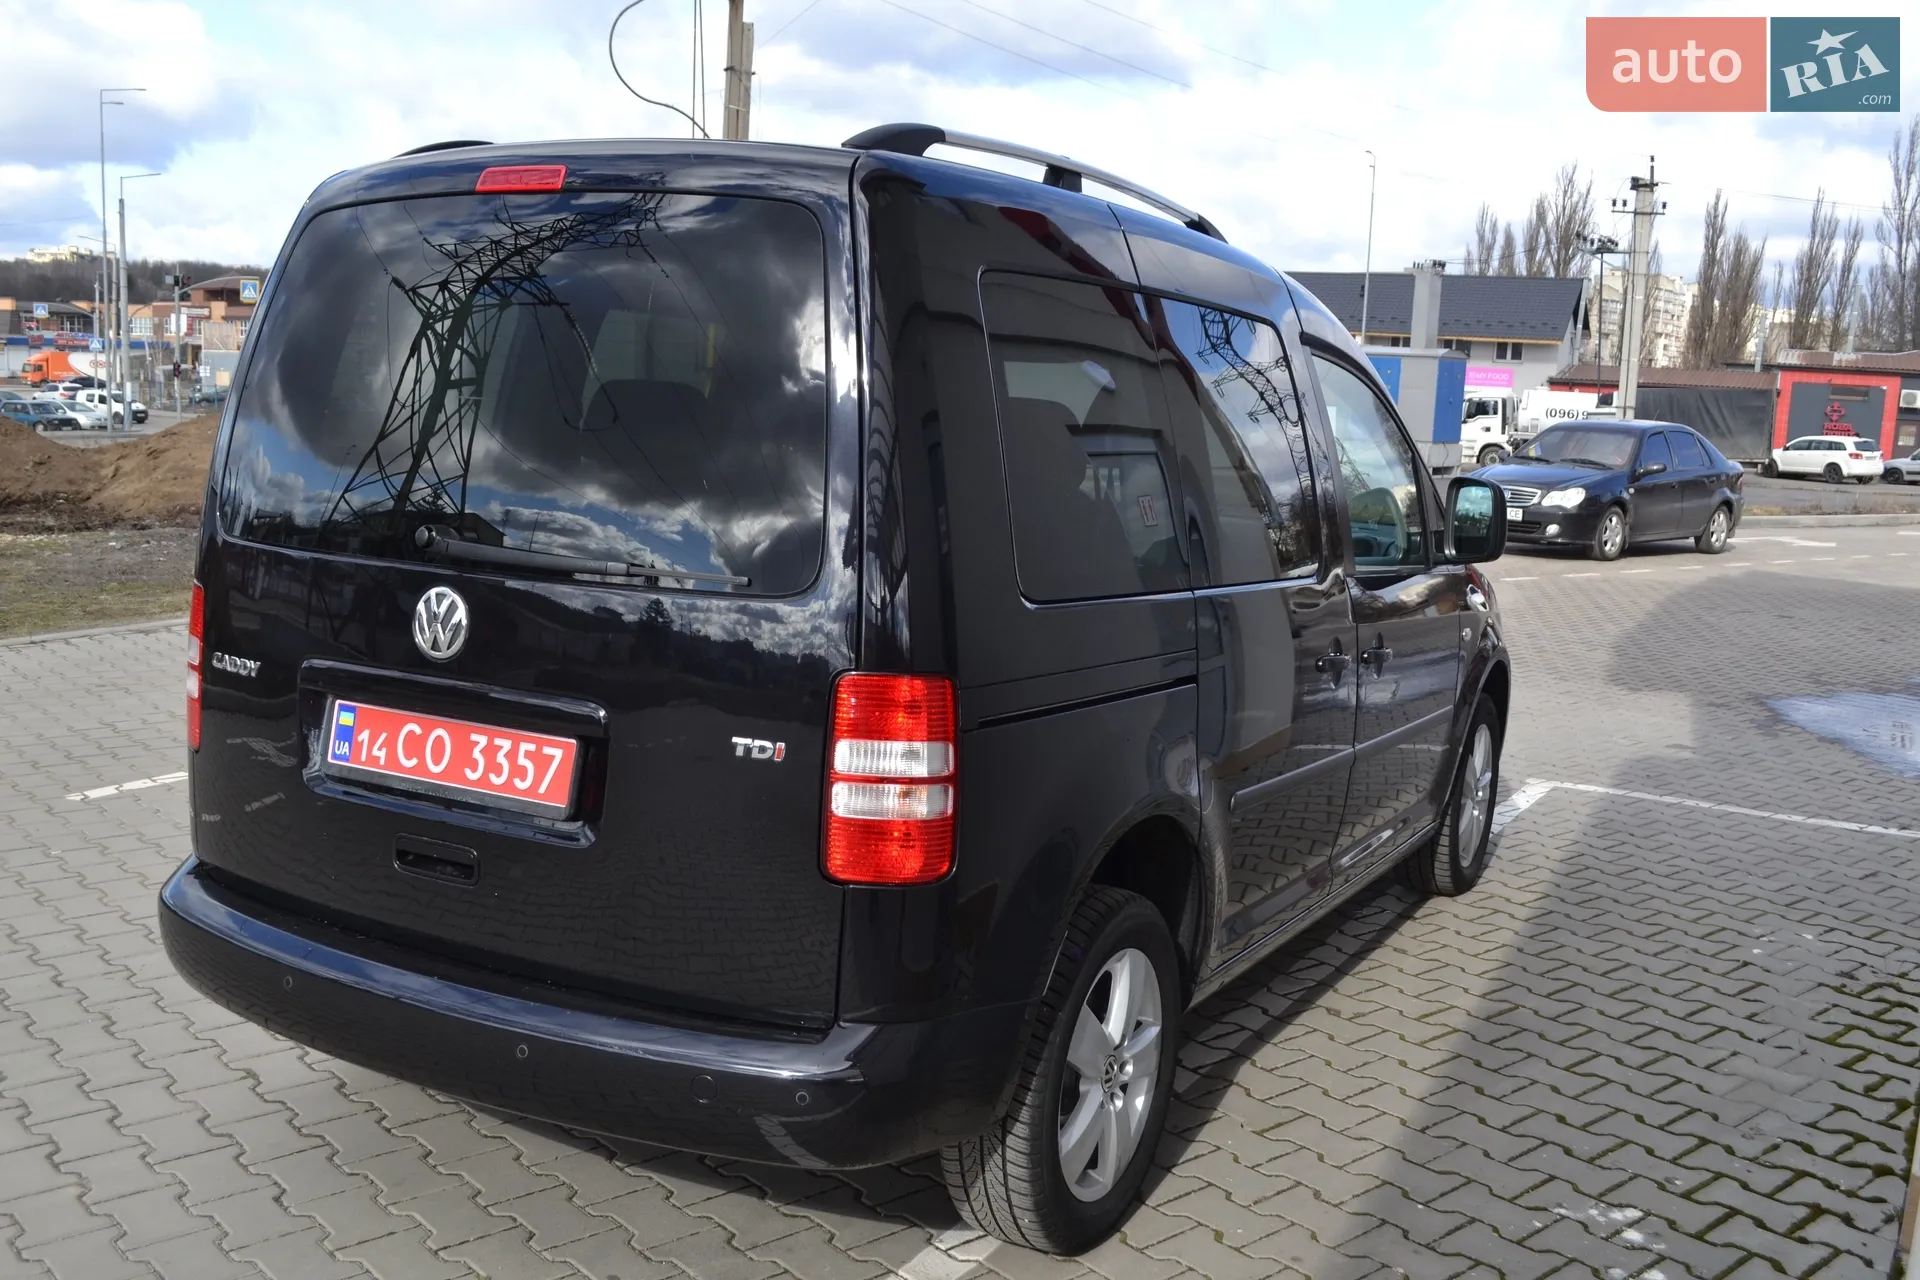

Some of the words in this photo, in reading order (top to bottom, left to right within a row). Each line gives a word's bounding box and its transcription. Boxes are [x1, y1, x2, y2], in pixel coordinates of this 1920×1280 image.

[1545, 407, 1579, 421] (096)
[1581, 410, 1589, 420] 9
[1509, 509, 1521, 519] CE
[211, 651, 261, 678] CADDY
[335, 740, 350, 756] UA
[463, 732, 564, 795] 3357
